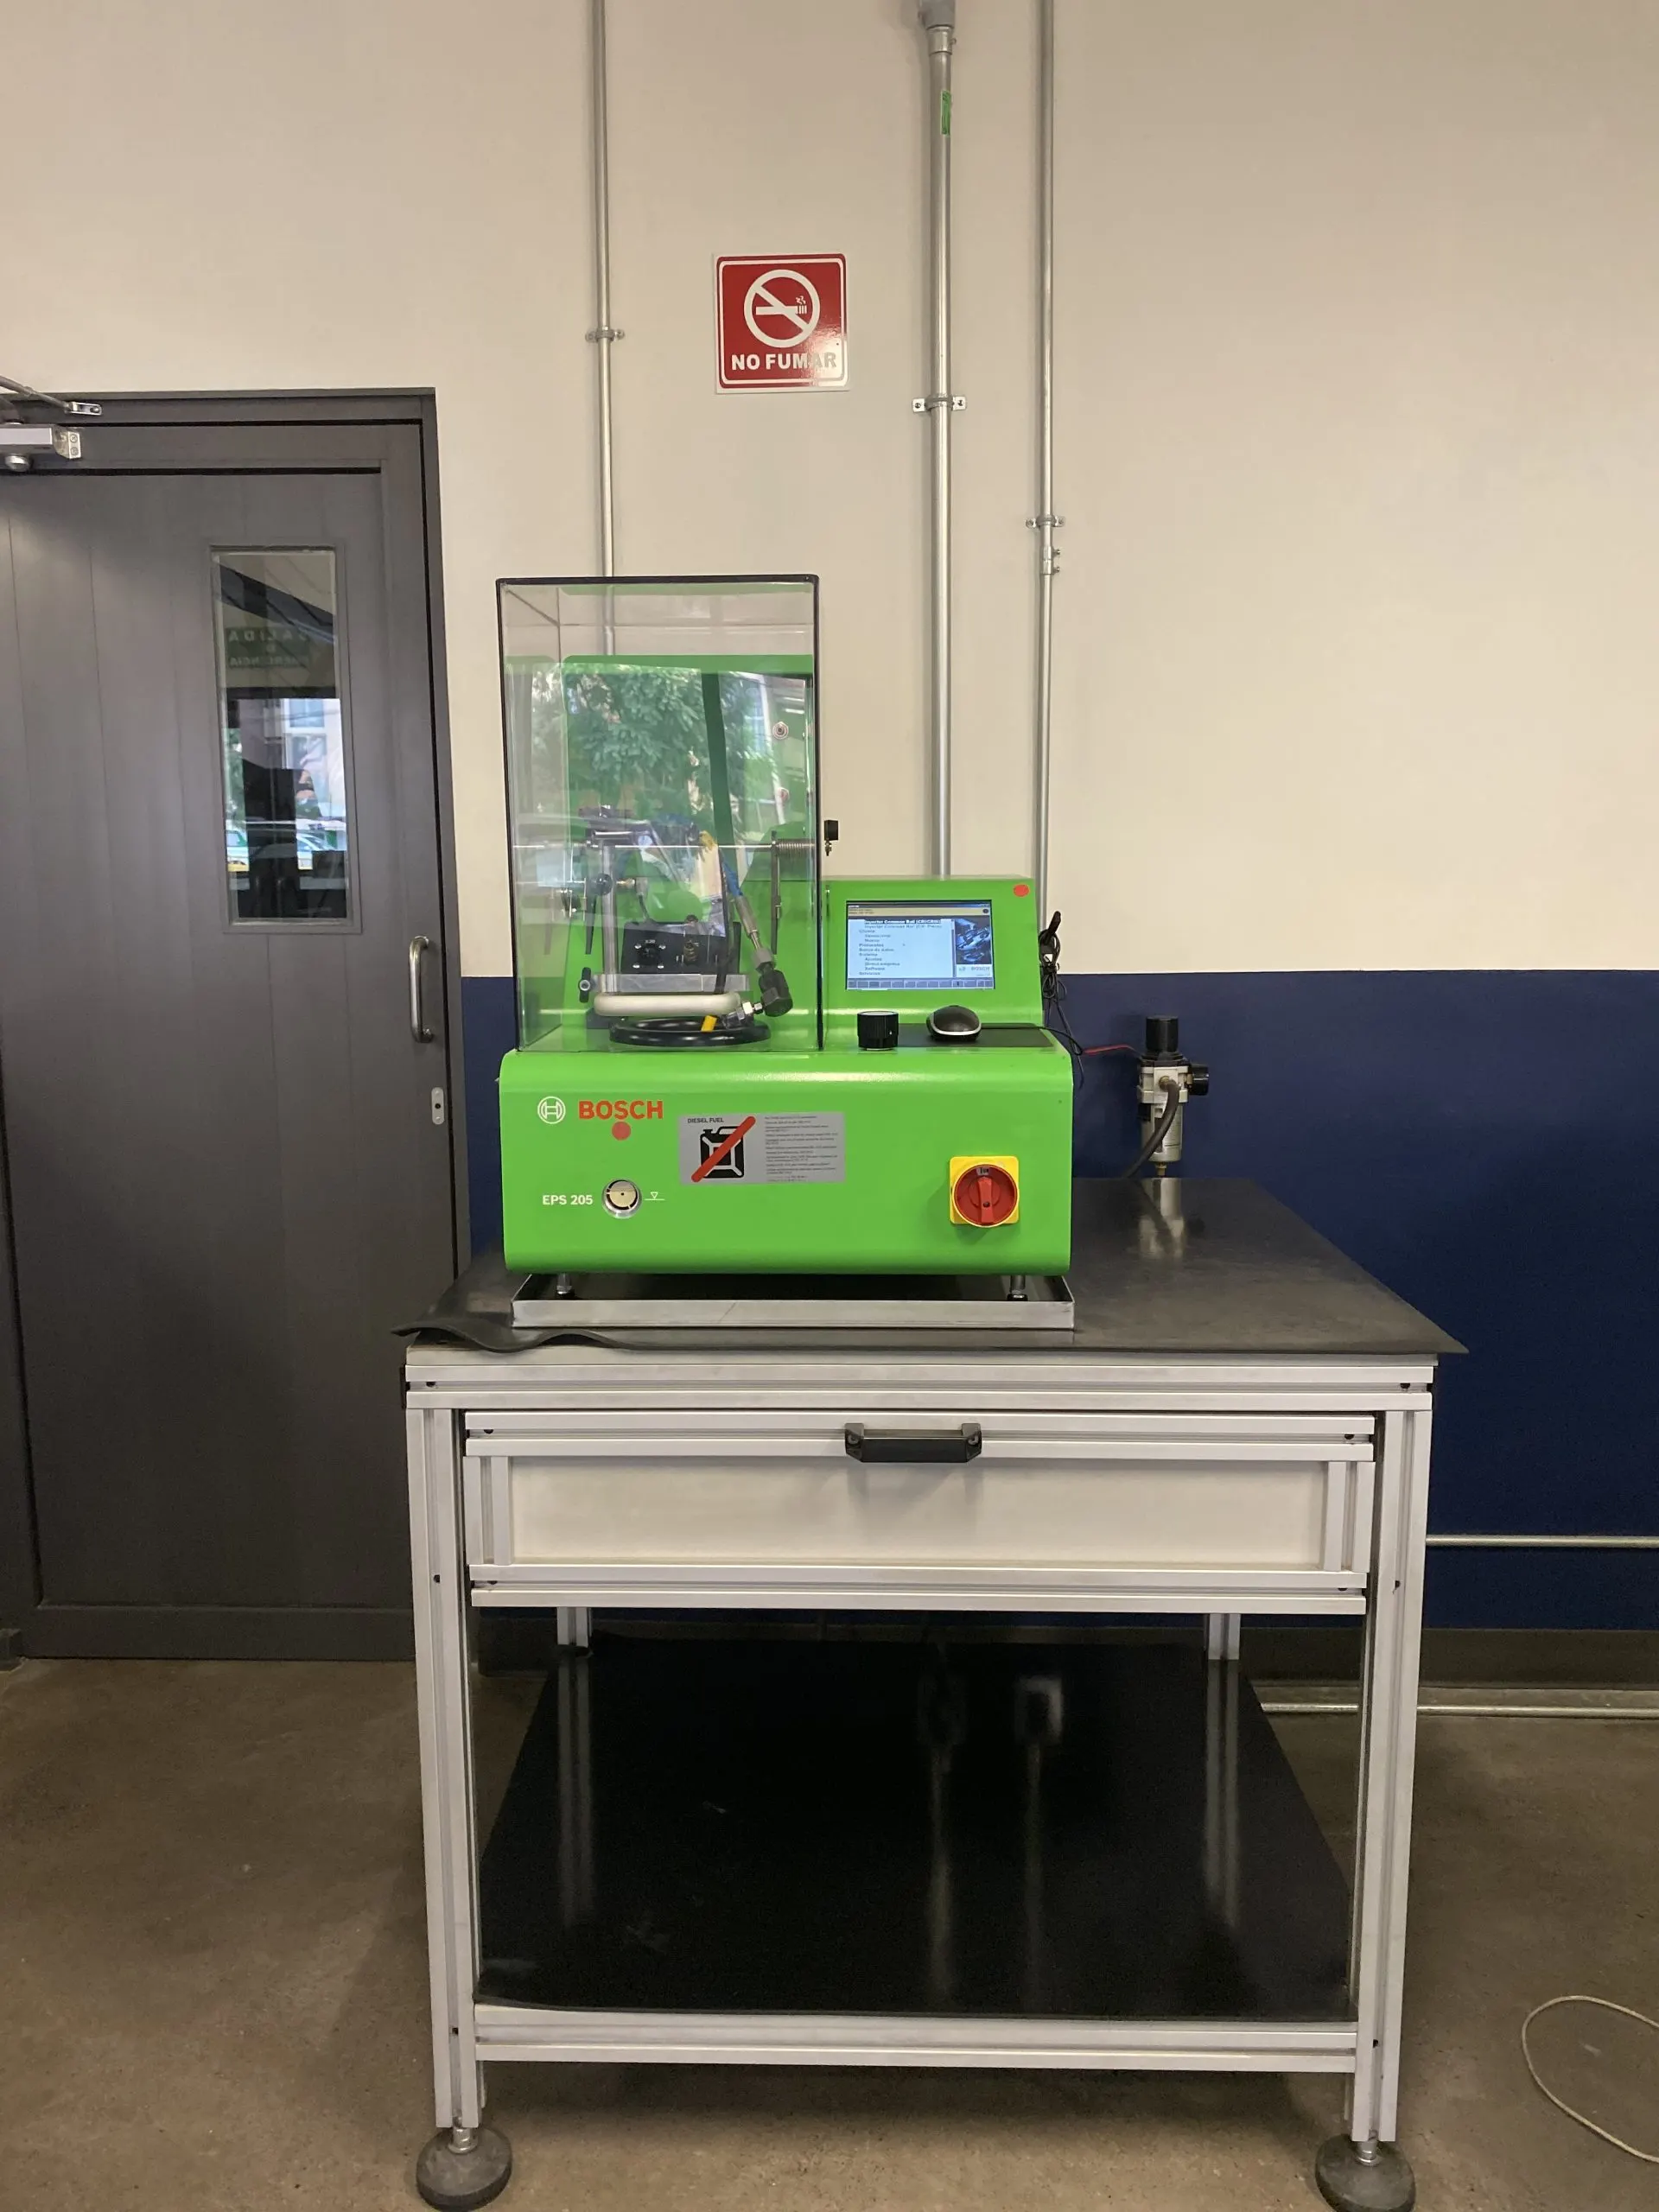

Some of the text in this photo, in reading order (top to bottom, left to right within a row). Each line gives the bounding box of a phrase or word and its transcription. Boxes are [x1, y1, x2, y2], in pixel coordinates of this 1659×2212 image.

[732, 353, 836, 370] NO FUMAR
[579, 1100, 663, 1120] BOSCH
[542, 1195, 594, 1205] EPS 205
